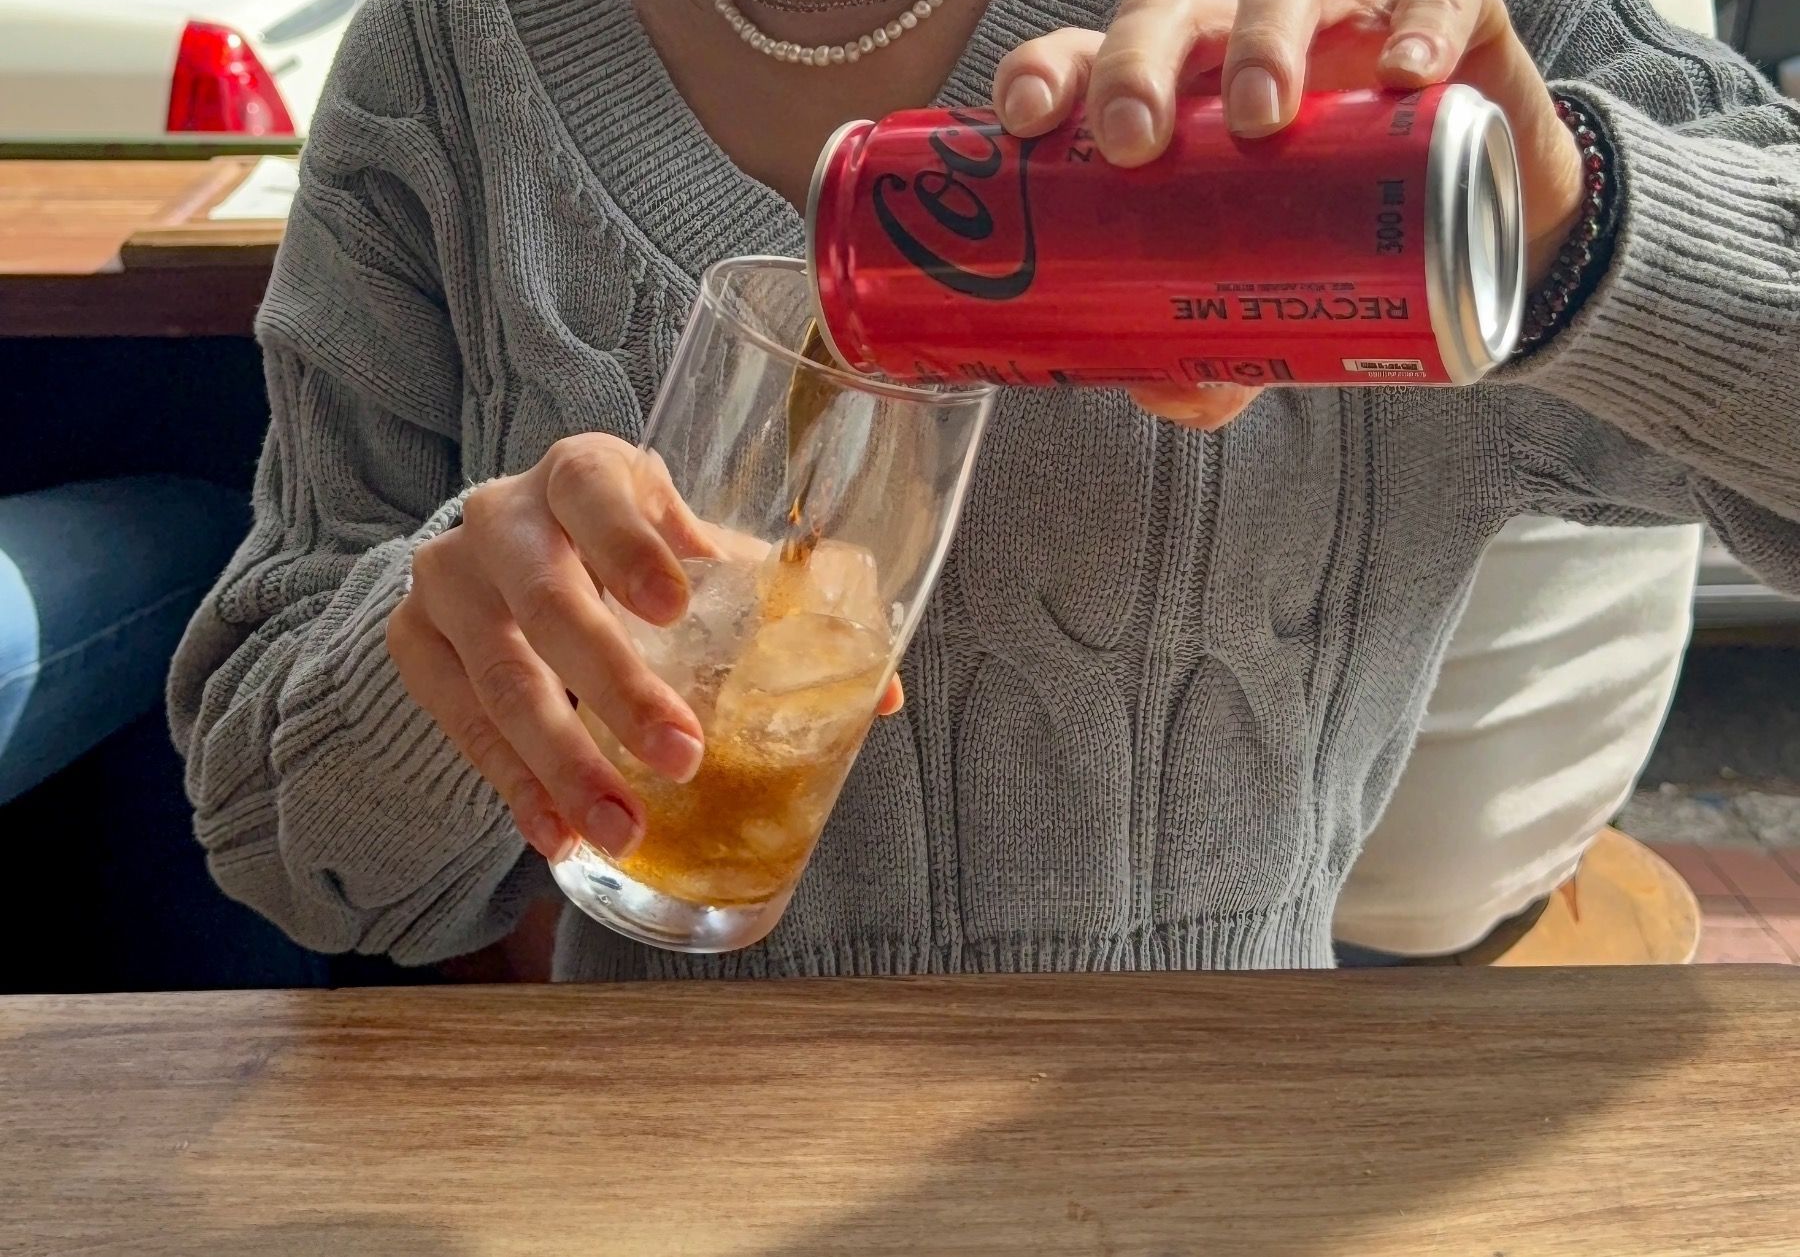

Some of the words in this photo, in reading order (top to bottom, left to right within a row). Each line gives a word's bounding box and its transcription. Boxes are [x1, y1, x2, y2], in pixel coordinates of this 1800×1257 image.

[1377, 212, 1404, 255] 300
[1170, 296, 1228, 321] ME
[1238, 295, 1409, 321] RECYCLE
